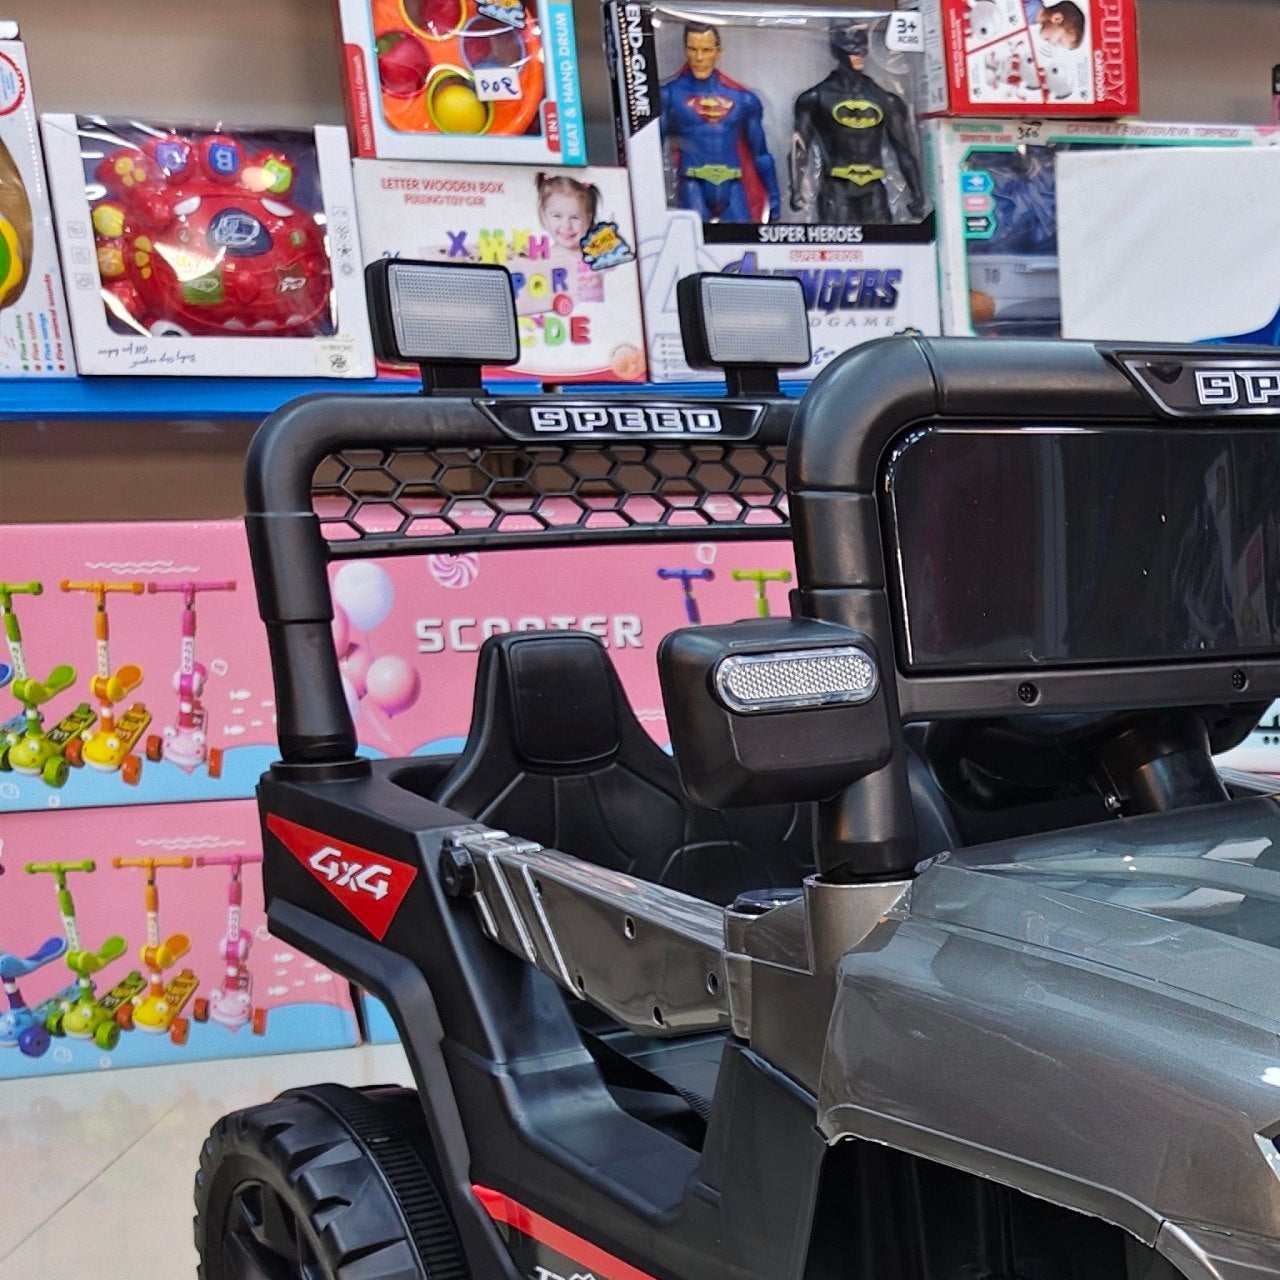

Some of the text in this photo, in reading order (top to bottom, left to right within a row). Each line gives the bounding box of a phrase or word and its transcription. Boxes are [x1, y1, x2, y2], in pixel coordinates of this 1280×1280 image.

[555, 12, 570, 56] DRUM
[896, 18, 916, 34] 3+
[625, 5, 651, 117] END-GAME
[1099, 0, 1127, 105] PUPPY
[559, 60, 574, 102] HAND
[564, 123, 581, 156] BEAT
[381, 178, 504, 194] LETTER WOODEN BOX
[759, 225, 864, 243] SUPER HEROES
[530, 407, 722, 432] SPEED
